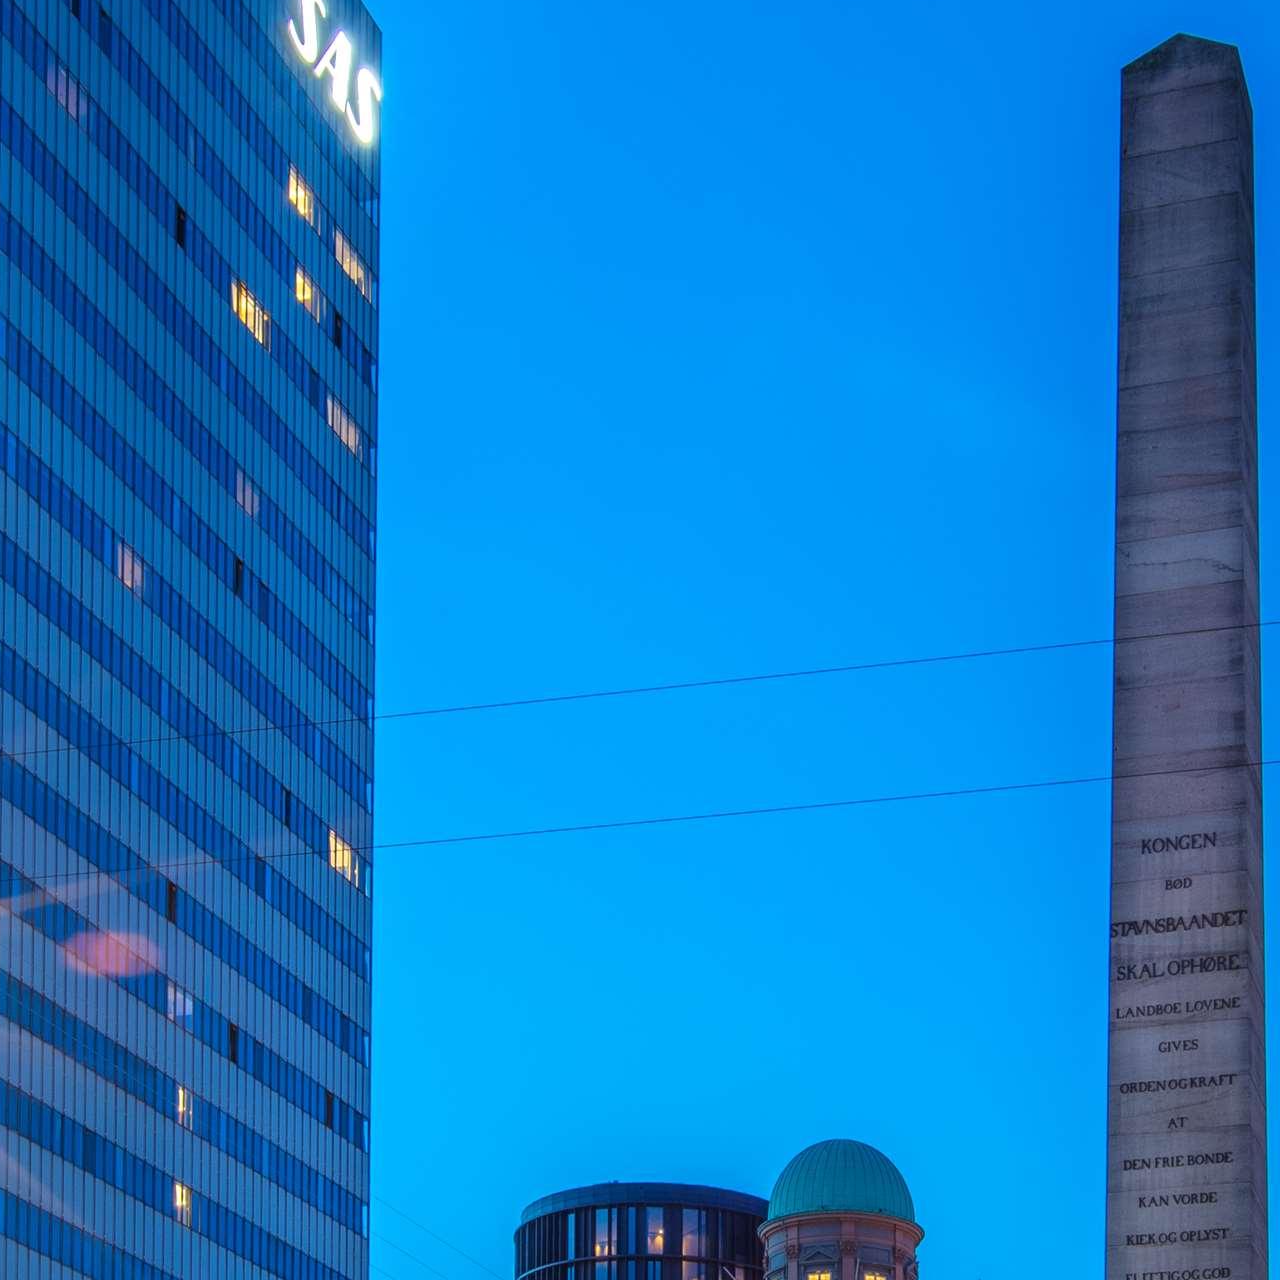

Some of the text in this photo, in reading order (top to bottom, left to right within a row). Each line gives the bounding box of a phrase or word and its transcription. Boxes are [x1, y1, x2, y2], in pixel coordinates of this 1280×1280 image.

[1141, 832, 1217, 855] KONGEN
[1165, 877, 1192, 890] BØD
[1111, 909, 1248, 938] STAVNSBAANDET
[1117, 954, 1240, 981] SKAL OPHØRE
[1116, 997, 1241, 1019] LANDBOE LOVENE
[1158, 1039, 1199, 1053] GIVES
[1120, 1074, 1237, 1094] ORDEN OG KRAFT
[1168, 1117, 1189, 1129] AT
[1123, 1152, 1234, 1171] DEN FRIE BONDE
[1138, 1192, 1218, 1208] KAN VORDE
[1158, 1231, 1177, 1244] OG
[1180, 1228, 1230, 1242] OPLYST
[1181, 1269, 1200, 1280] OG
[1202, 1267, 1231, 1280] GOD
